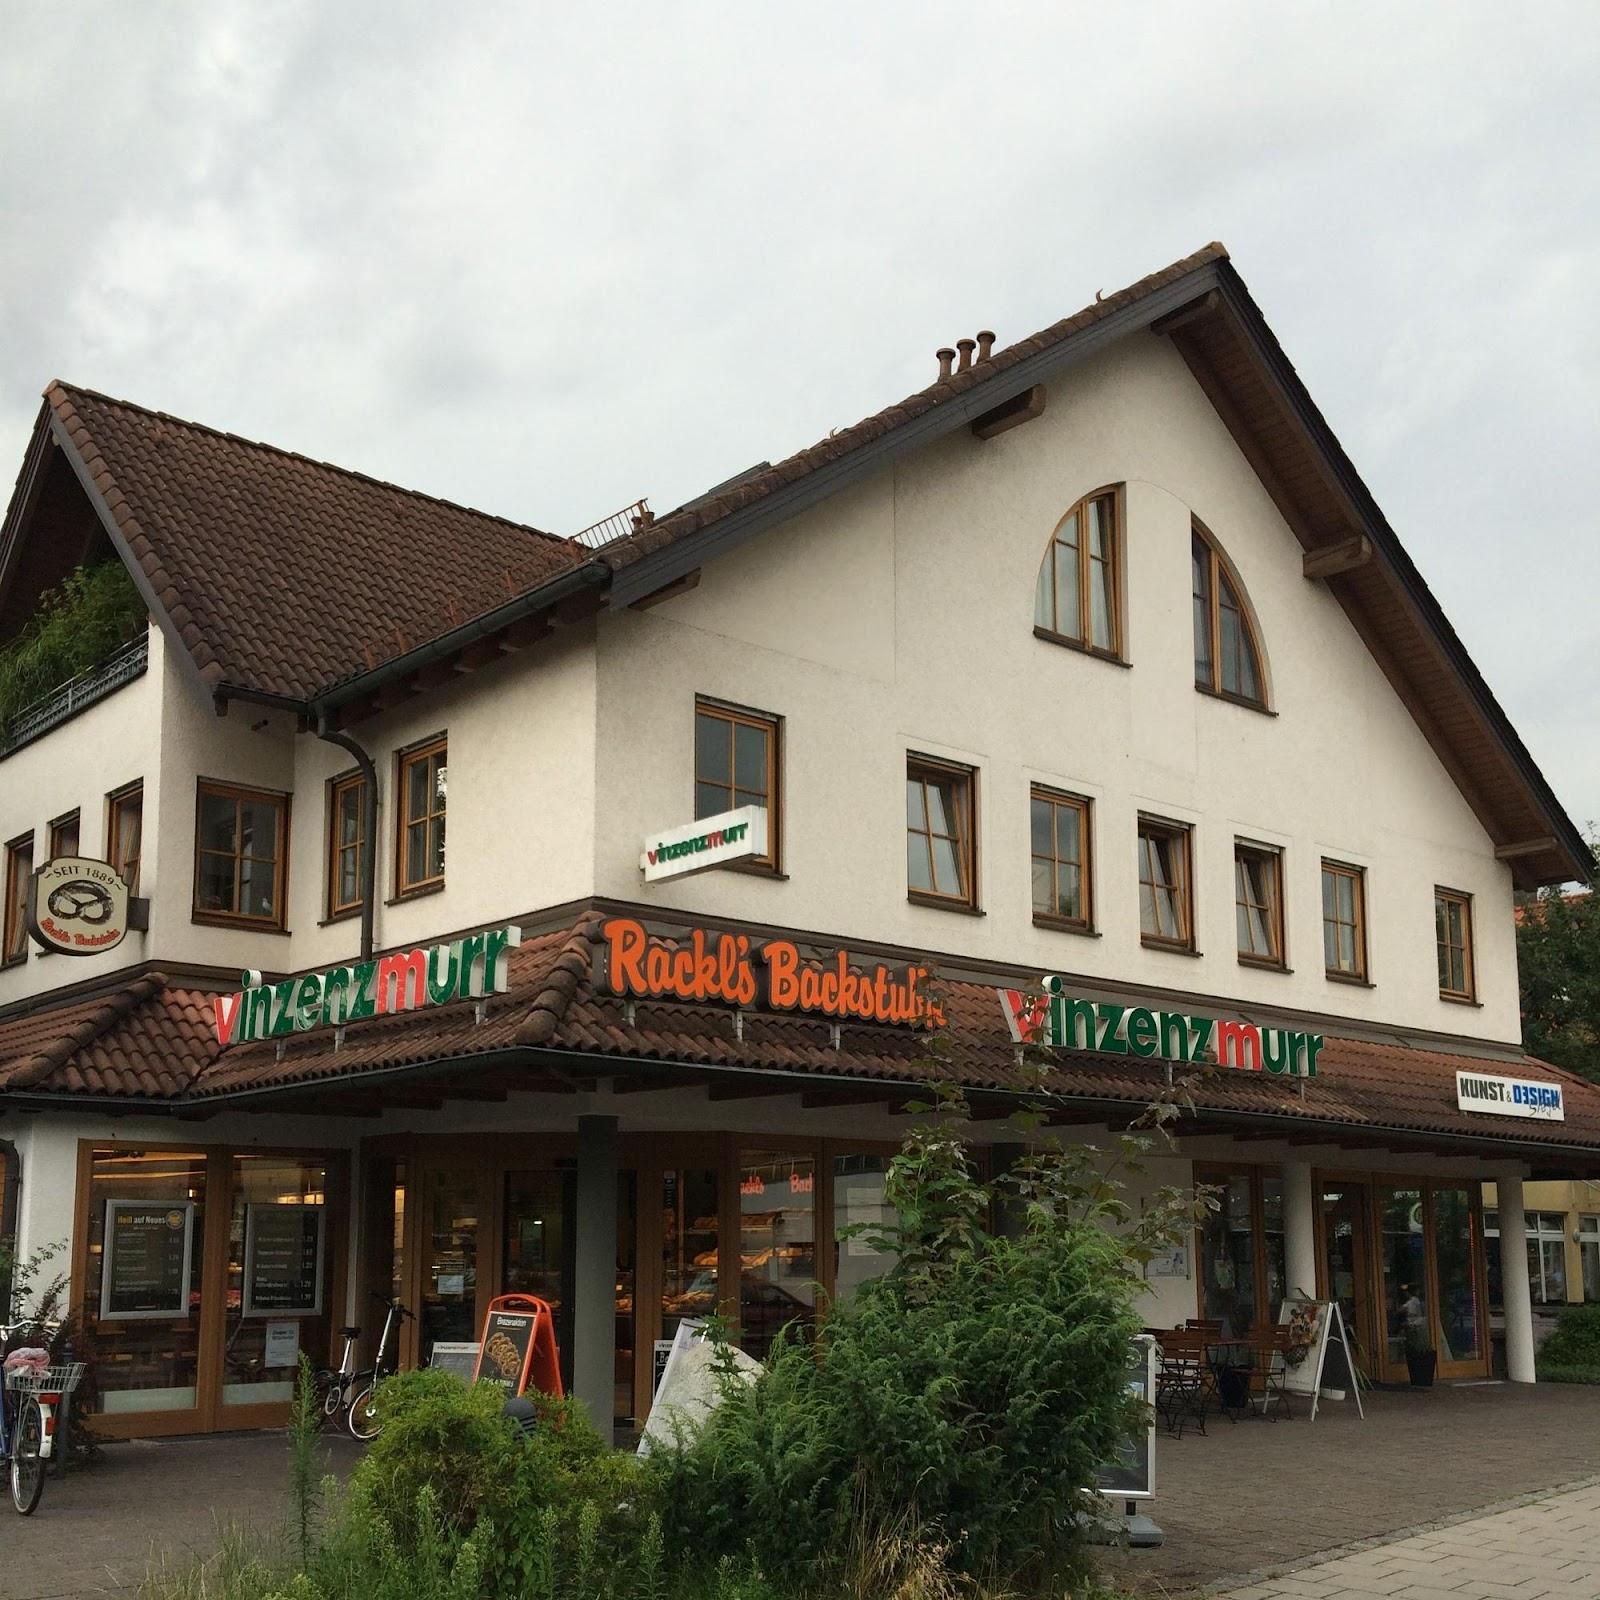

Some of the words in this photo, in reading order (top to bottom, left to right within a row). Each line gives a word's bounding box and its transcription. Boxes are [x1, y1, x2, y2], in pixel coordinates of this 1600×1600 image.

[53, 865, 80, 878] SEIT
[84, 867, 115, 885] 1889
[214, 925, 521, 1046] vinzenzmurr
[604, 918, 756, 1006] Rackl's
[996, 975, 1324, 1078] vinzenzmurr
[1459, 1077, 1505, 1103] KUNST
[1506, 1090, 1513, 1104] &
